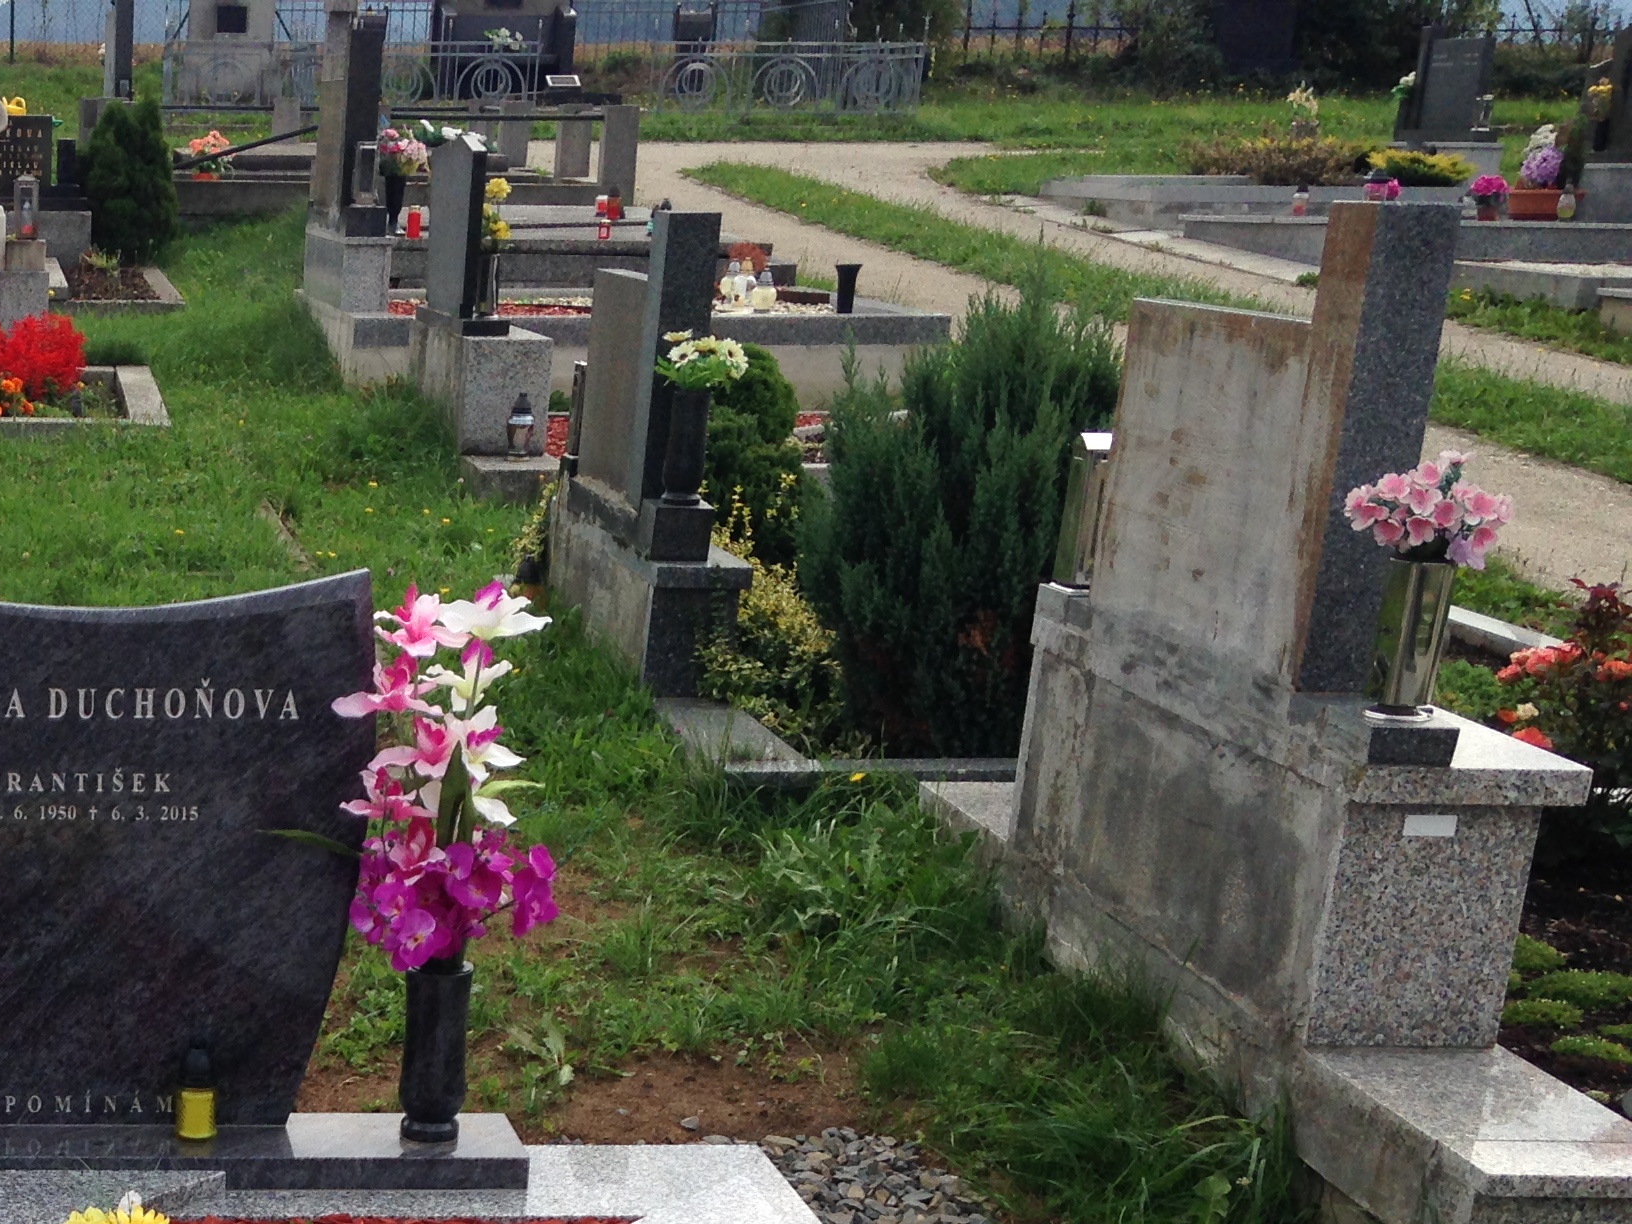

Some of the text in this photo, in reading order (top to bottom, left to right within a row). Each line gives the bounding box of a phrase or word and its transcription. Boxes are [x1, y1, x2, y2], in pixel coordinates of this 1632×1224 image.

[47, 677, 300, 720] DUCHOŇOVA
[13, 805, 28, 820] 6.
[39, 805, 77, 820] 1950
[111, 806, 126, 821] 6.
[135, 806, 150, 821] 3.
[160, 806, 199, 821] 2015
